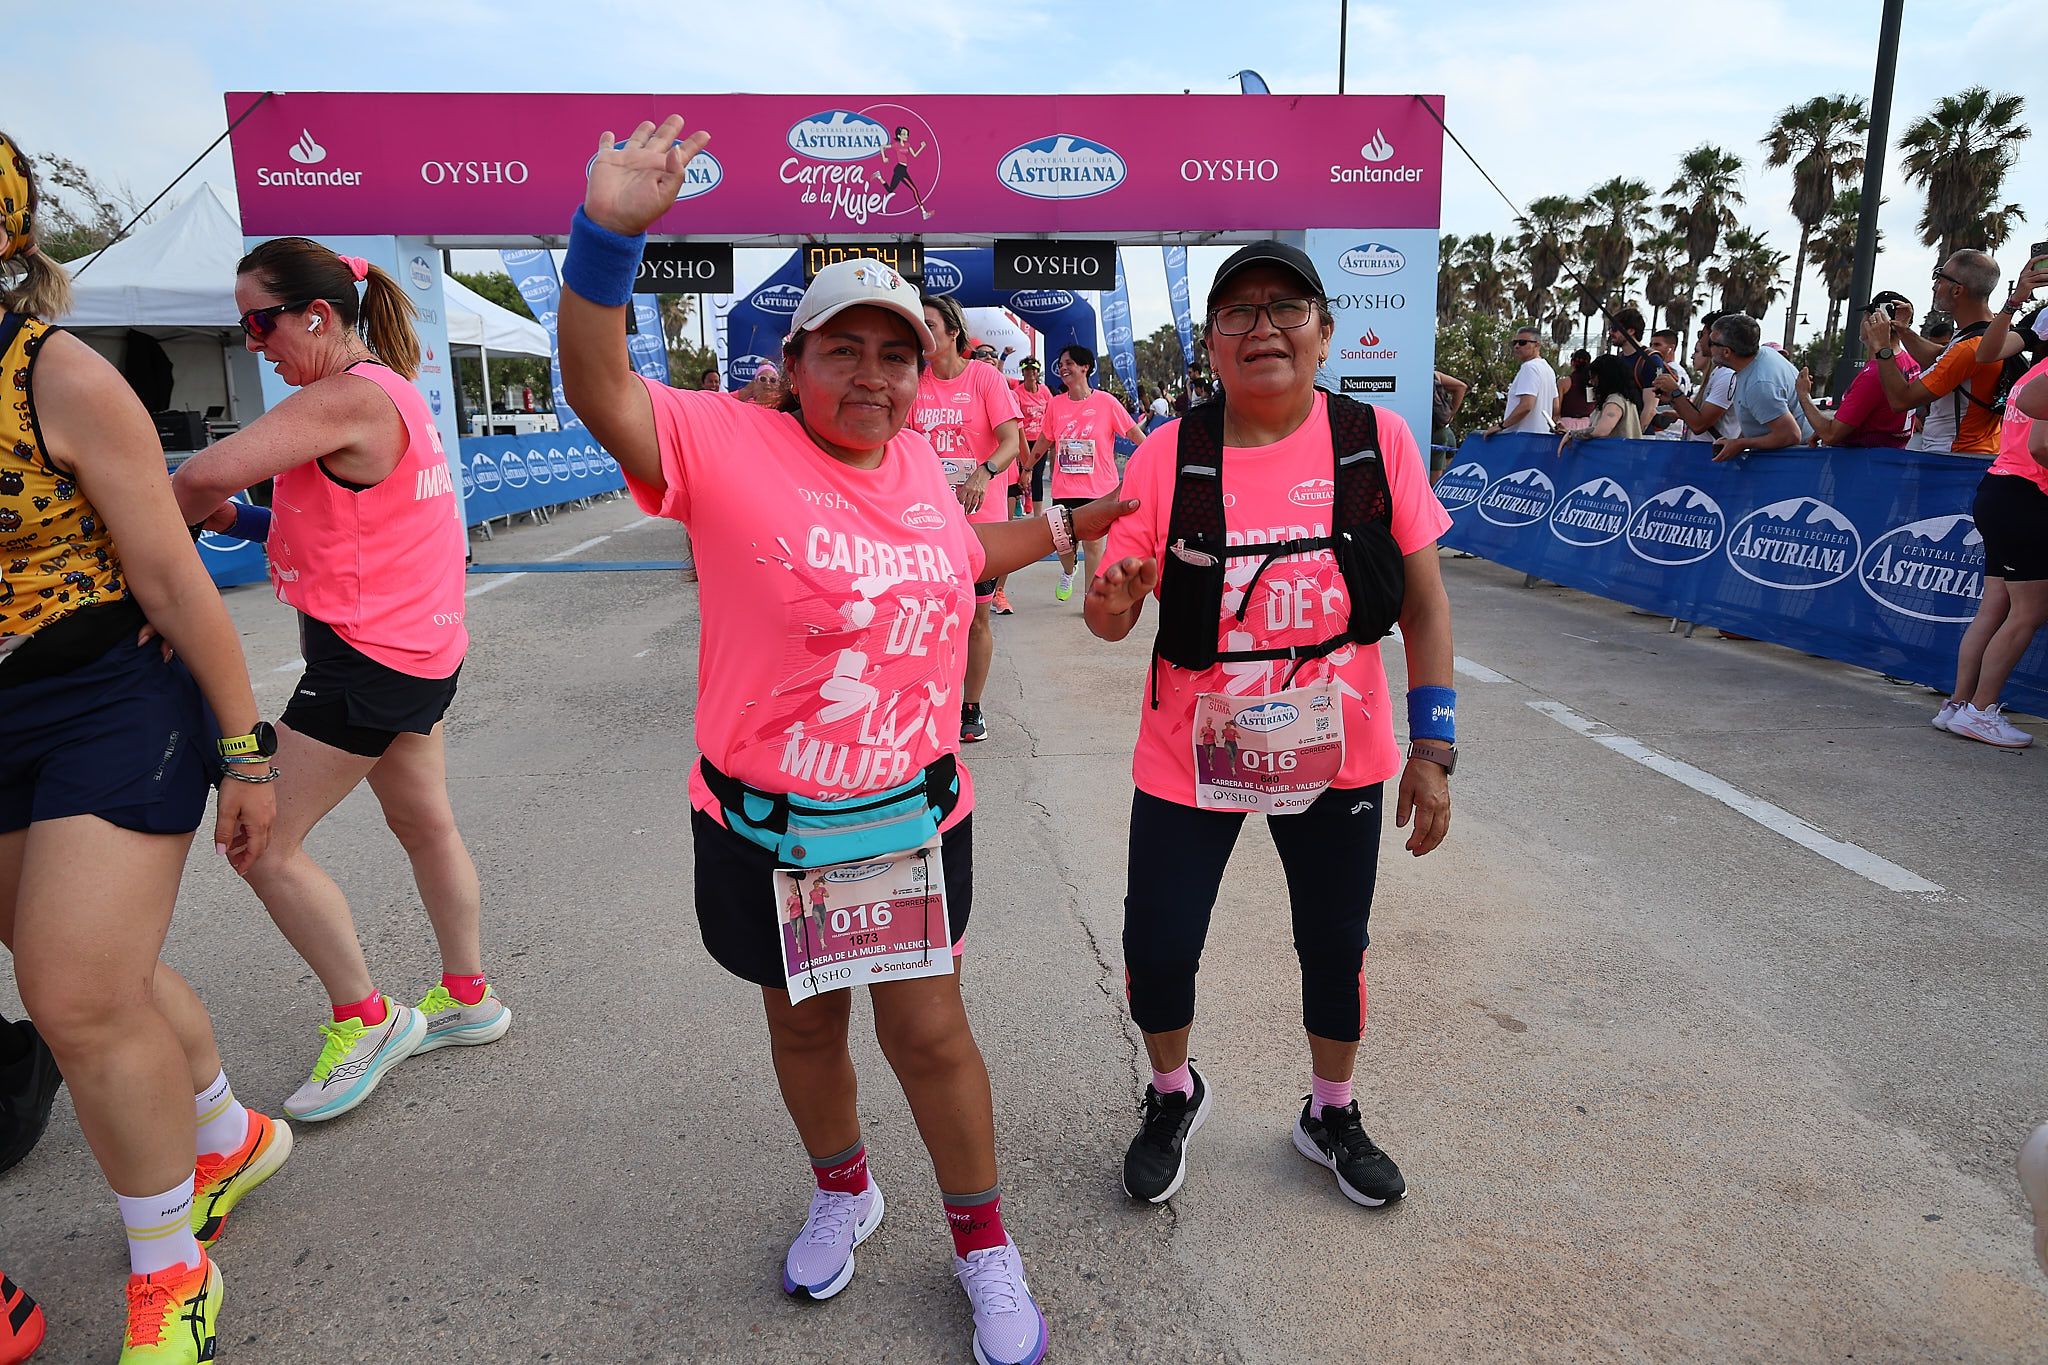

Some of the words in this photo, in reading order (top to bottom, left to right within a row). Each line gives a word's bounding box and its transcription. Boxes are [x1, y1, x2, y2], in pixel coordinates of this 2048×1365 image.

[796, 129, 882, 148] ASTURIANA
[1071, 156, 1113, 164] LECHERA
[257, 168, 362, 186] Santander
[421, 160, 529, 184] OYSHO
[779, 157, 864, 185] Carrera
[1008, 158, 1117, 183] ASTURIANA
[1180, 159, 1279, 182] OYSHO
[1330, 165, 1424, 184] Santander
[801, 188, 816, 203] de
[820, 187, 832, 203] la
[829, 182, 896, 225] Mujer
[1013, 255, 1099, 276] OYSHO
[1343, 256, 1400, 268] ASTURIANA
[755, 289, 801, 307] ASTURIA
[1015, 294, 1070, 308] ASTURIANA
[1337, 294, 1405, 310] OYSHO
[1341, 349, 1398, 359] Santander
[1344, 379, 1392, 391] Neutrogena
[1293, 490, 1334, 501] ASTURIAN
[1481, 484, 1545, 517] ASTURIANA
[1575, 499, 1598, 508] CENTRAL
[1600, 503, 1626, 513] LECHERA
[1554, 499, 1622, 534] ASTURIANA
[1653, 509, 1682, 522] CENTRAL
[1684, 513, 1717, 526] LECHERA
[1630, 510, 1714, 550] ASTURIANA
[1760, 524, 1801, 539] CENTRAL
[1804, 530, 1850, 545] LECHERA
[1732, 524, 1846, 573] ASTURIANA
[1902, 545, 1956, 562] CENTRAL
[1265, 577, 1316, 631] DE
[433, 612, 463, 626] OYS
[884, 595, 946, 657] DE
[857, 688, 899, 746] LA
[1208, 702, 1231, 715] SUMA
[1240, 712, 1295, 726] ASTURIANA
[778, 737, 911, 791] MUJER
[1242, 750, 1298, 772] 016
[1211, 778, 1243, 788] CARRERA
[1245, 781, 1254, 789] DE
[1255, 783, 1265, 791] LA
[1266, 783, 1290, 793] MUJER
[1261, 774, 1279, 784] 640
[1213, 791, 1258, 804] OYSHO
[831, 902, 893, 933] 016
[850, 933, 878, 946] 1873
[800, 954, 833, 970] CARRERA
[836, 951, 846, 959] DE
[848, 950, 858, 958] LA
[860, 945, 887, 956] MUJER
[894, 940, 931, 951] VALENCIA
[884, 959, 933, 972] Santander
[803, 967, 851, 988] OYSHO
